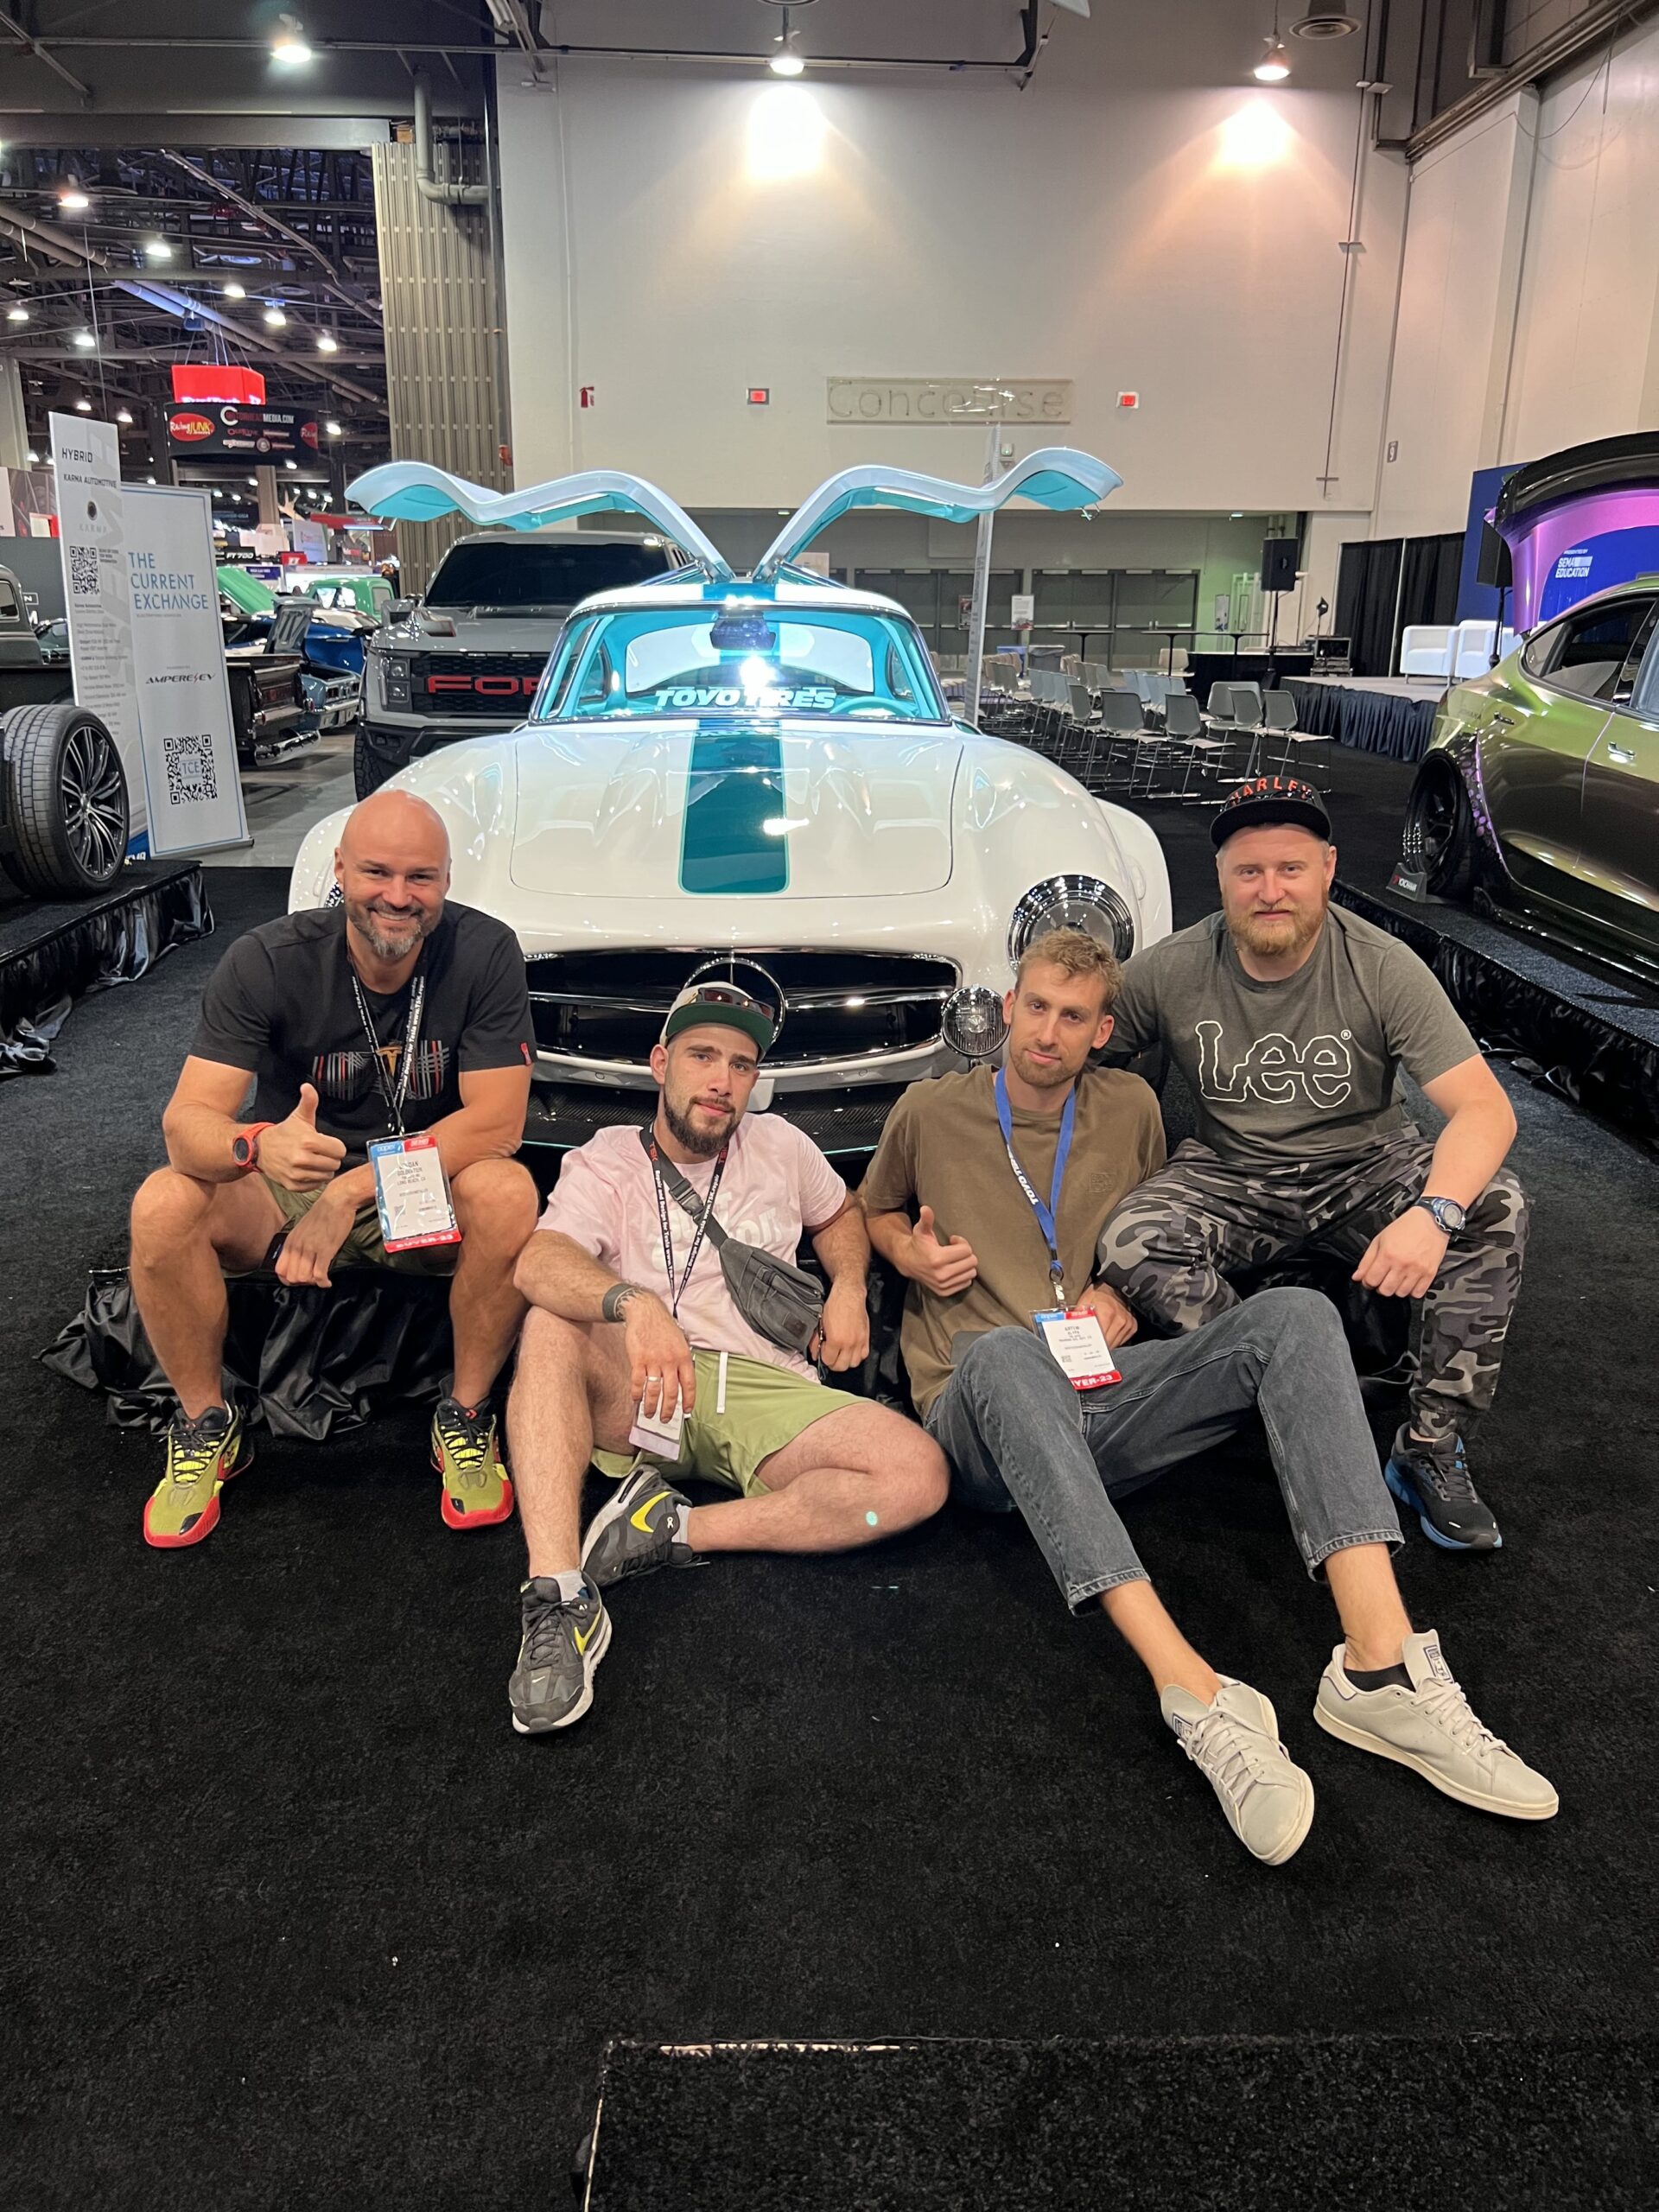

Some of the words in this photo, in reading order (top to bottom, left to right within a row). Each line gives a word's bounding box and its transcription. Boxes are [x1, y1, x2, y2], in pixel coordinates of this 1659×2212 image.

[829, 381, 1065, 418] Concourse
[61, 448, 93, 463] HYBRID
[63, 474, 83, 484] KARMA
[84, 476, 118, 489] AUTOMOTIVE
[128, 551, 156, 569] THE
[130, 573, 194, 590] CURRENT
[1555, 567, 1590, 578] EDUCATION
[134, 594, 209, 610] EXCHANGE
[428, 675, 542, 696] FO
[655, 690, 741, 708] TOYO
[743, 690, 837, 709] TRES
[181, 761, 200, 775] TCE
[404, 1052, 412, 1075] Design
[413, 976, 424, 1025] www.TSK.repair
[1195, 1020, 1351, 1109] Lee
[649, 1142, 658, 1161] TSK
[1019, 1175, 1039, 1205] TOYO
[688, 1246, 697, 1267] Design
[697, 1220, 707, 1236] Tesla
[703, 1174, 720, 1220] www.TSK.repair
[1072, 1374, 1113, 1388] YER-23
